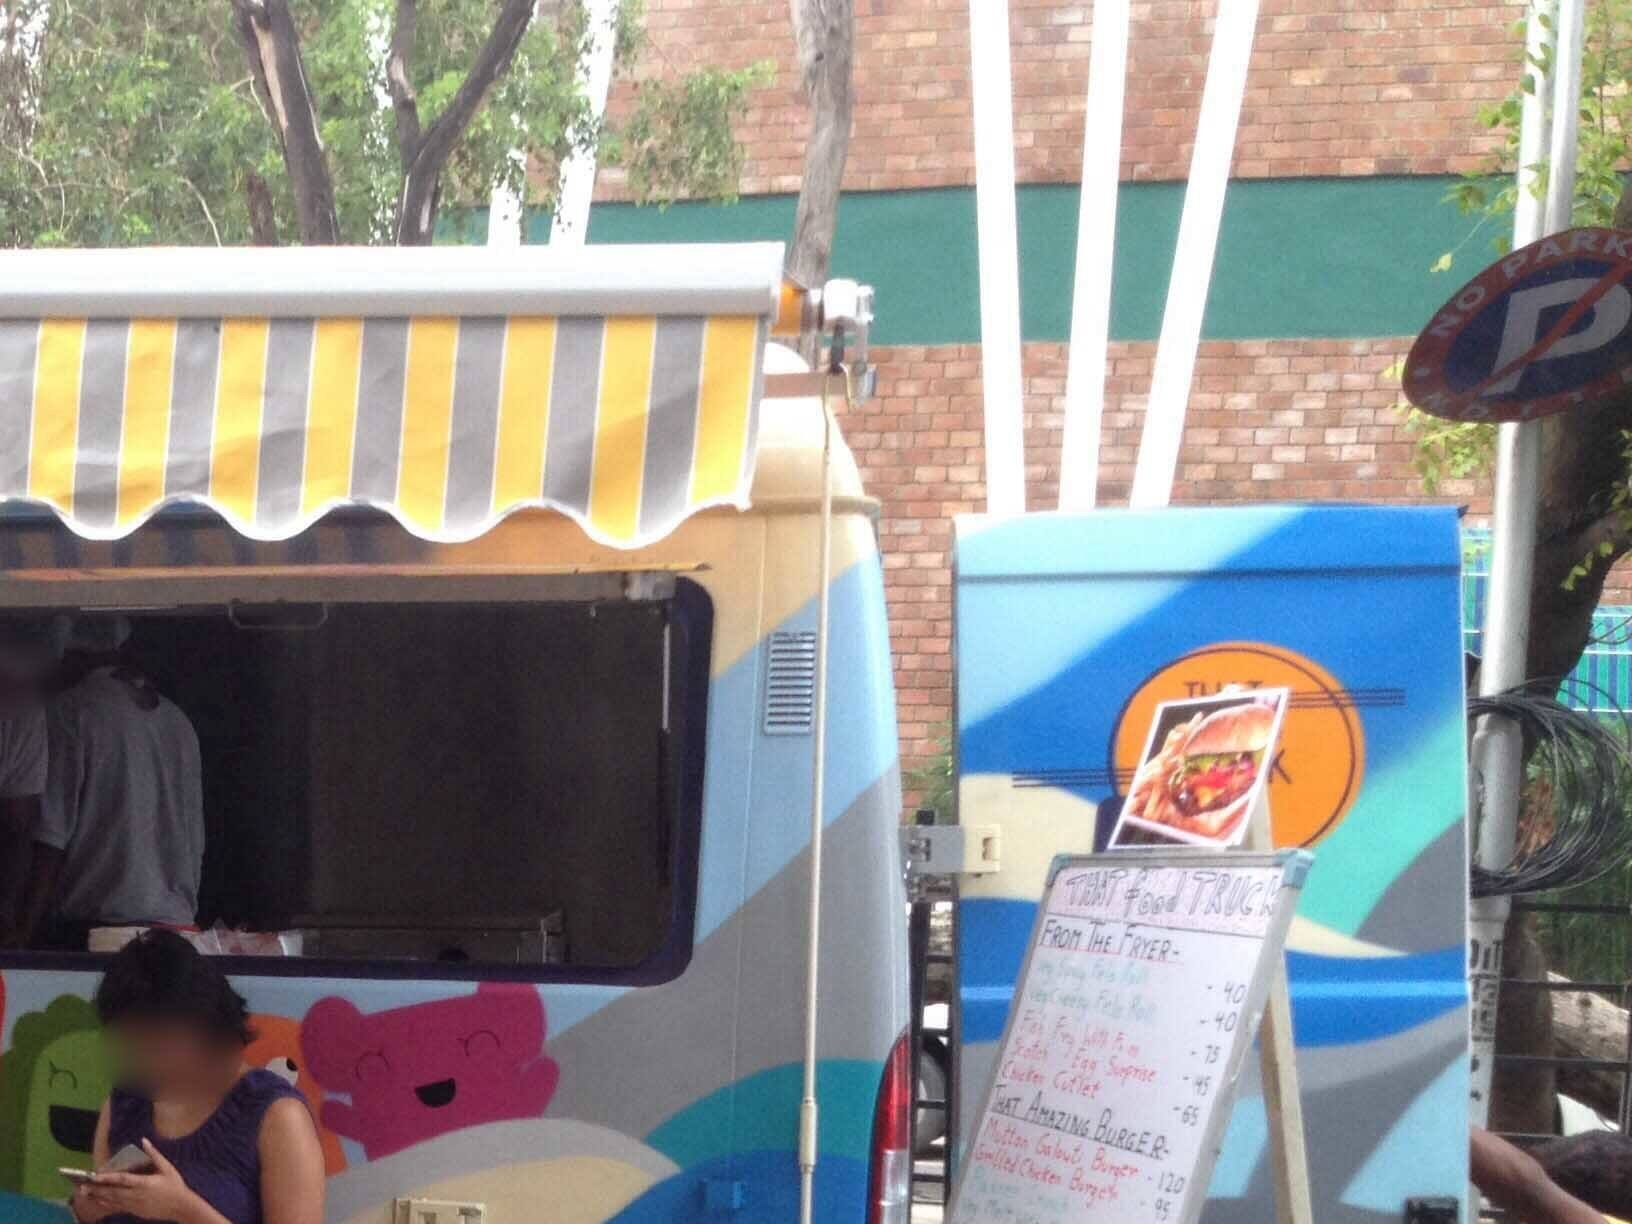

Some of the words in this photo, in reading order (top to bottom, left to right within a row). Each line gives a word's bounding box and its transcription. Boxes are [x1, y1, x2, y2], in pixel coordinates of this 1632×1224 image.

[1428, 285, 1487, 337] NO
[1502, 233, 1632, 280] PARK
[1066, 868, 1128, 908] THAT
[1188, 869, 1280, 918] TRUCK
[1039, 918, 1082, 949] FROM
[1087, 919, 1114, 954] THE
[991, 1083, 1021, 1113] THAT
